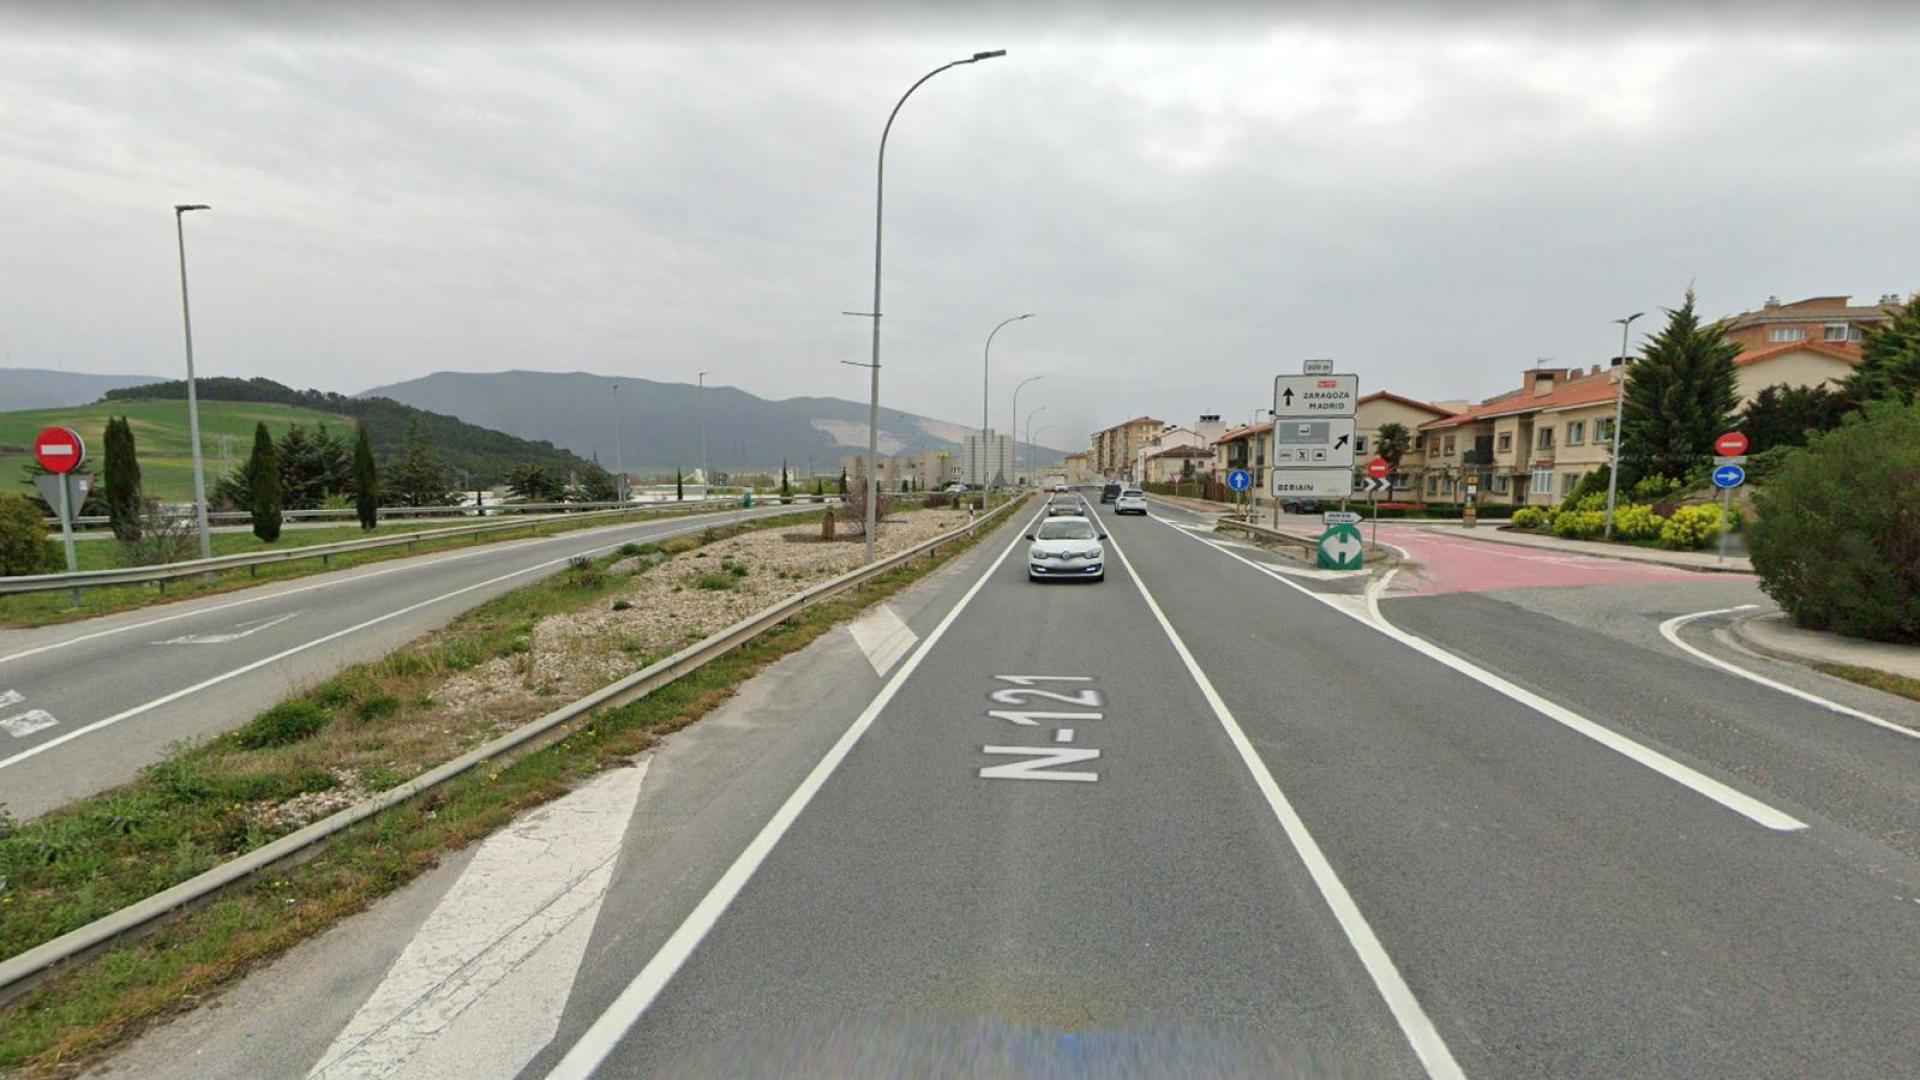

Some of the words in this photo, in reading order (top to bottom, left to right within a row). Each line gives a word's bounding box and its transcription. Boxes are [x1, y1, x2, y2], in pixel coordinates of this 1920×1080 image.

[1303, 391, 1350, 400] ZARAGOZA
[1309, 402, 1345, 410] MADRID
[979, 675, 1103, 782] N-121
